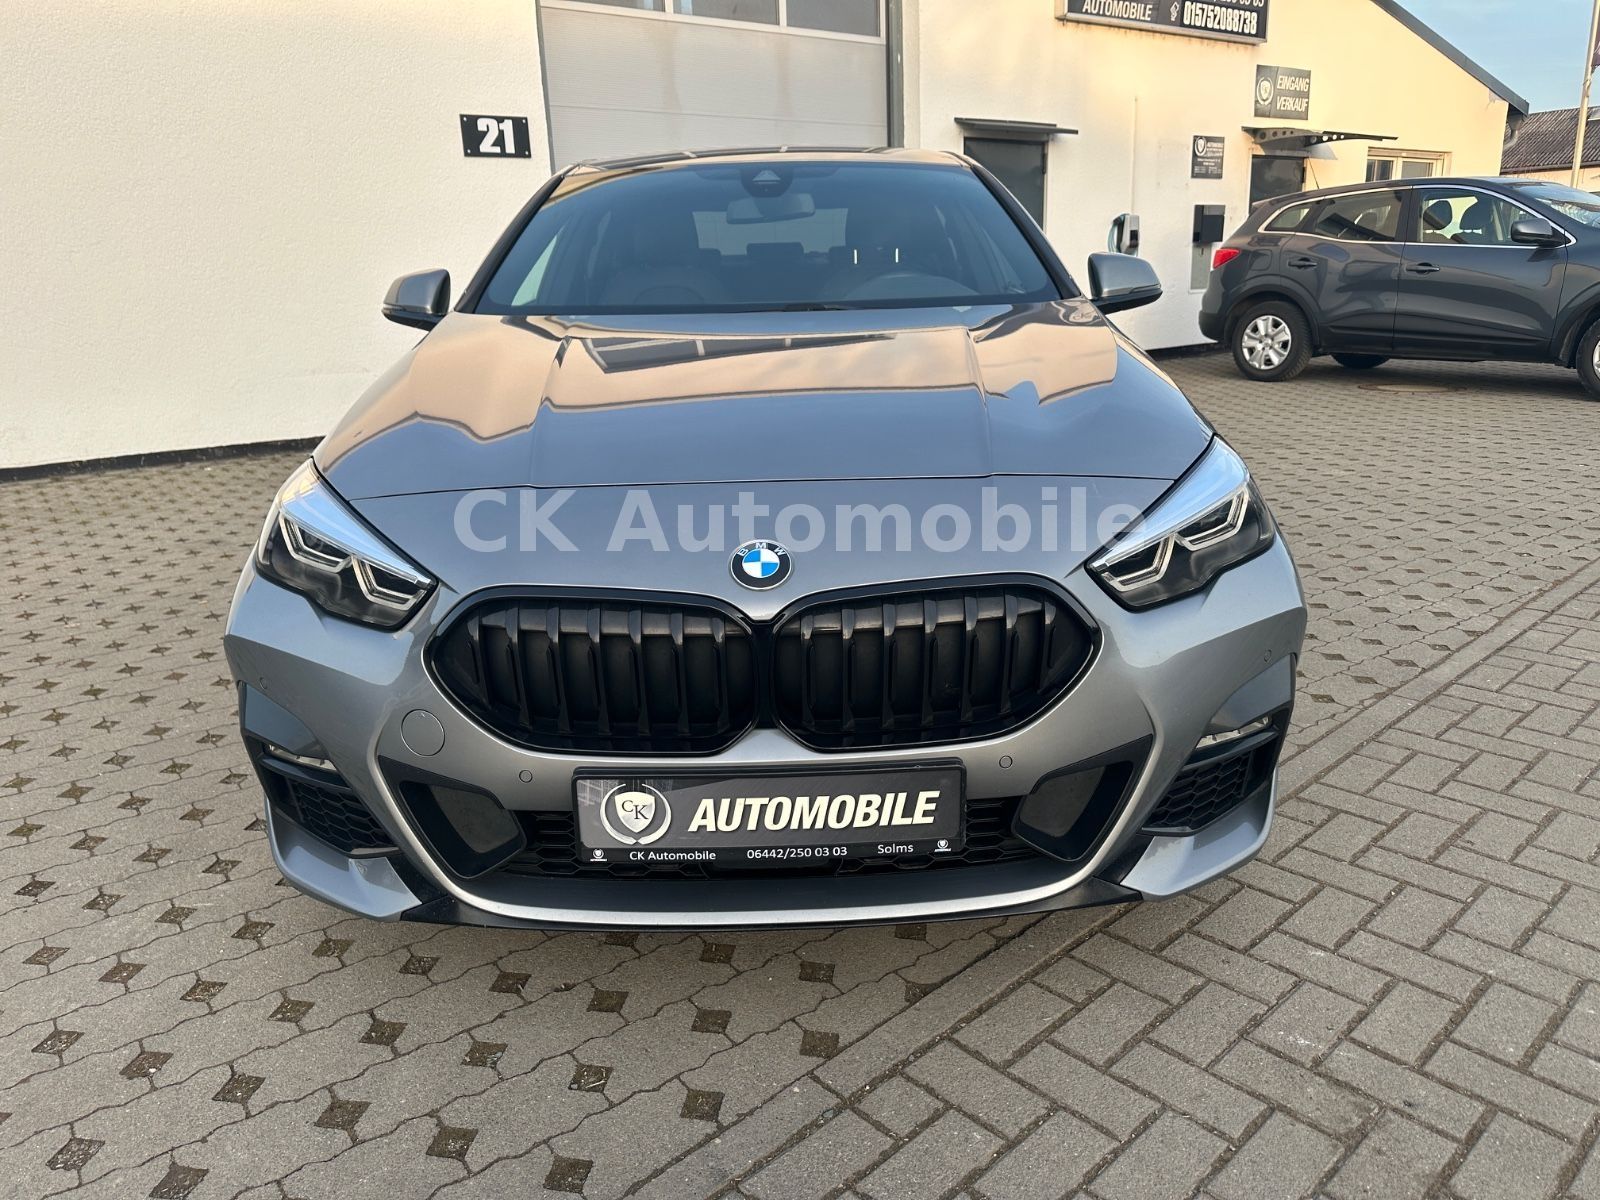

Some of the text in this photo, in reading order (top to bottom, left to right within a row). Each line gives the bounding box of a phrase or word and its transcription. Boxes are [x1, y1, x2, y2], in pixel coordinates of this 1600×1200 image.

[1082, 0, 1153, 21] AUTOMOBILE
[1183, 1, 1258, 35] 015752088738
[1276, 75, 1310, 92] EINGANG
[1276, 95, 1309, 112] VERKAUF
[477, 117, 516, 154] 21
[737, 542, 787, 557] BMW
[621, 799, 649, 820] CK
[688, 790, 941, 833] AUTOMOBILE
[629, 843, 914, 861] CK Automobile 06442/250 03 03 Solms
